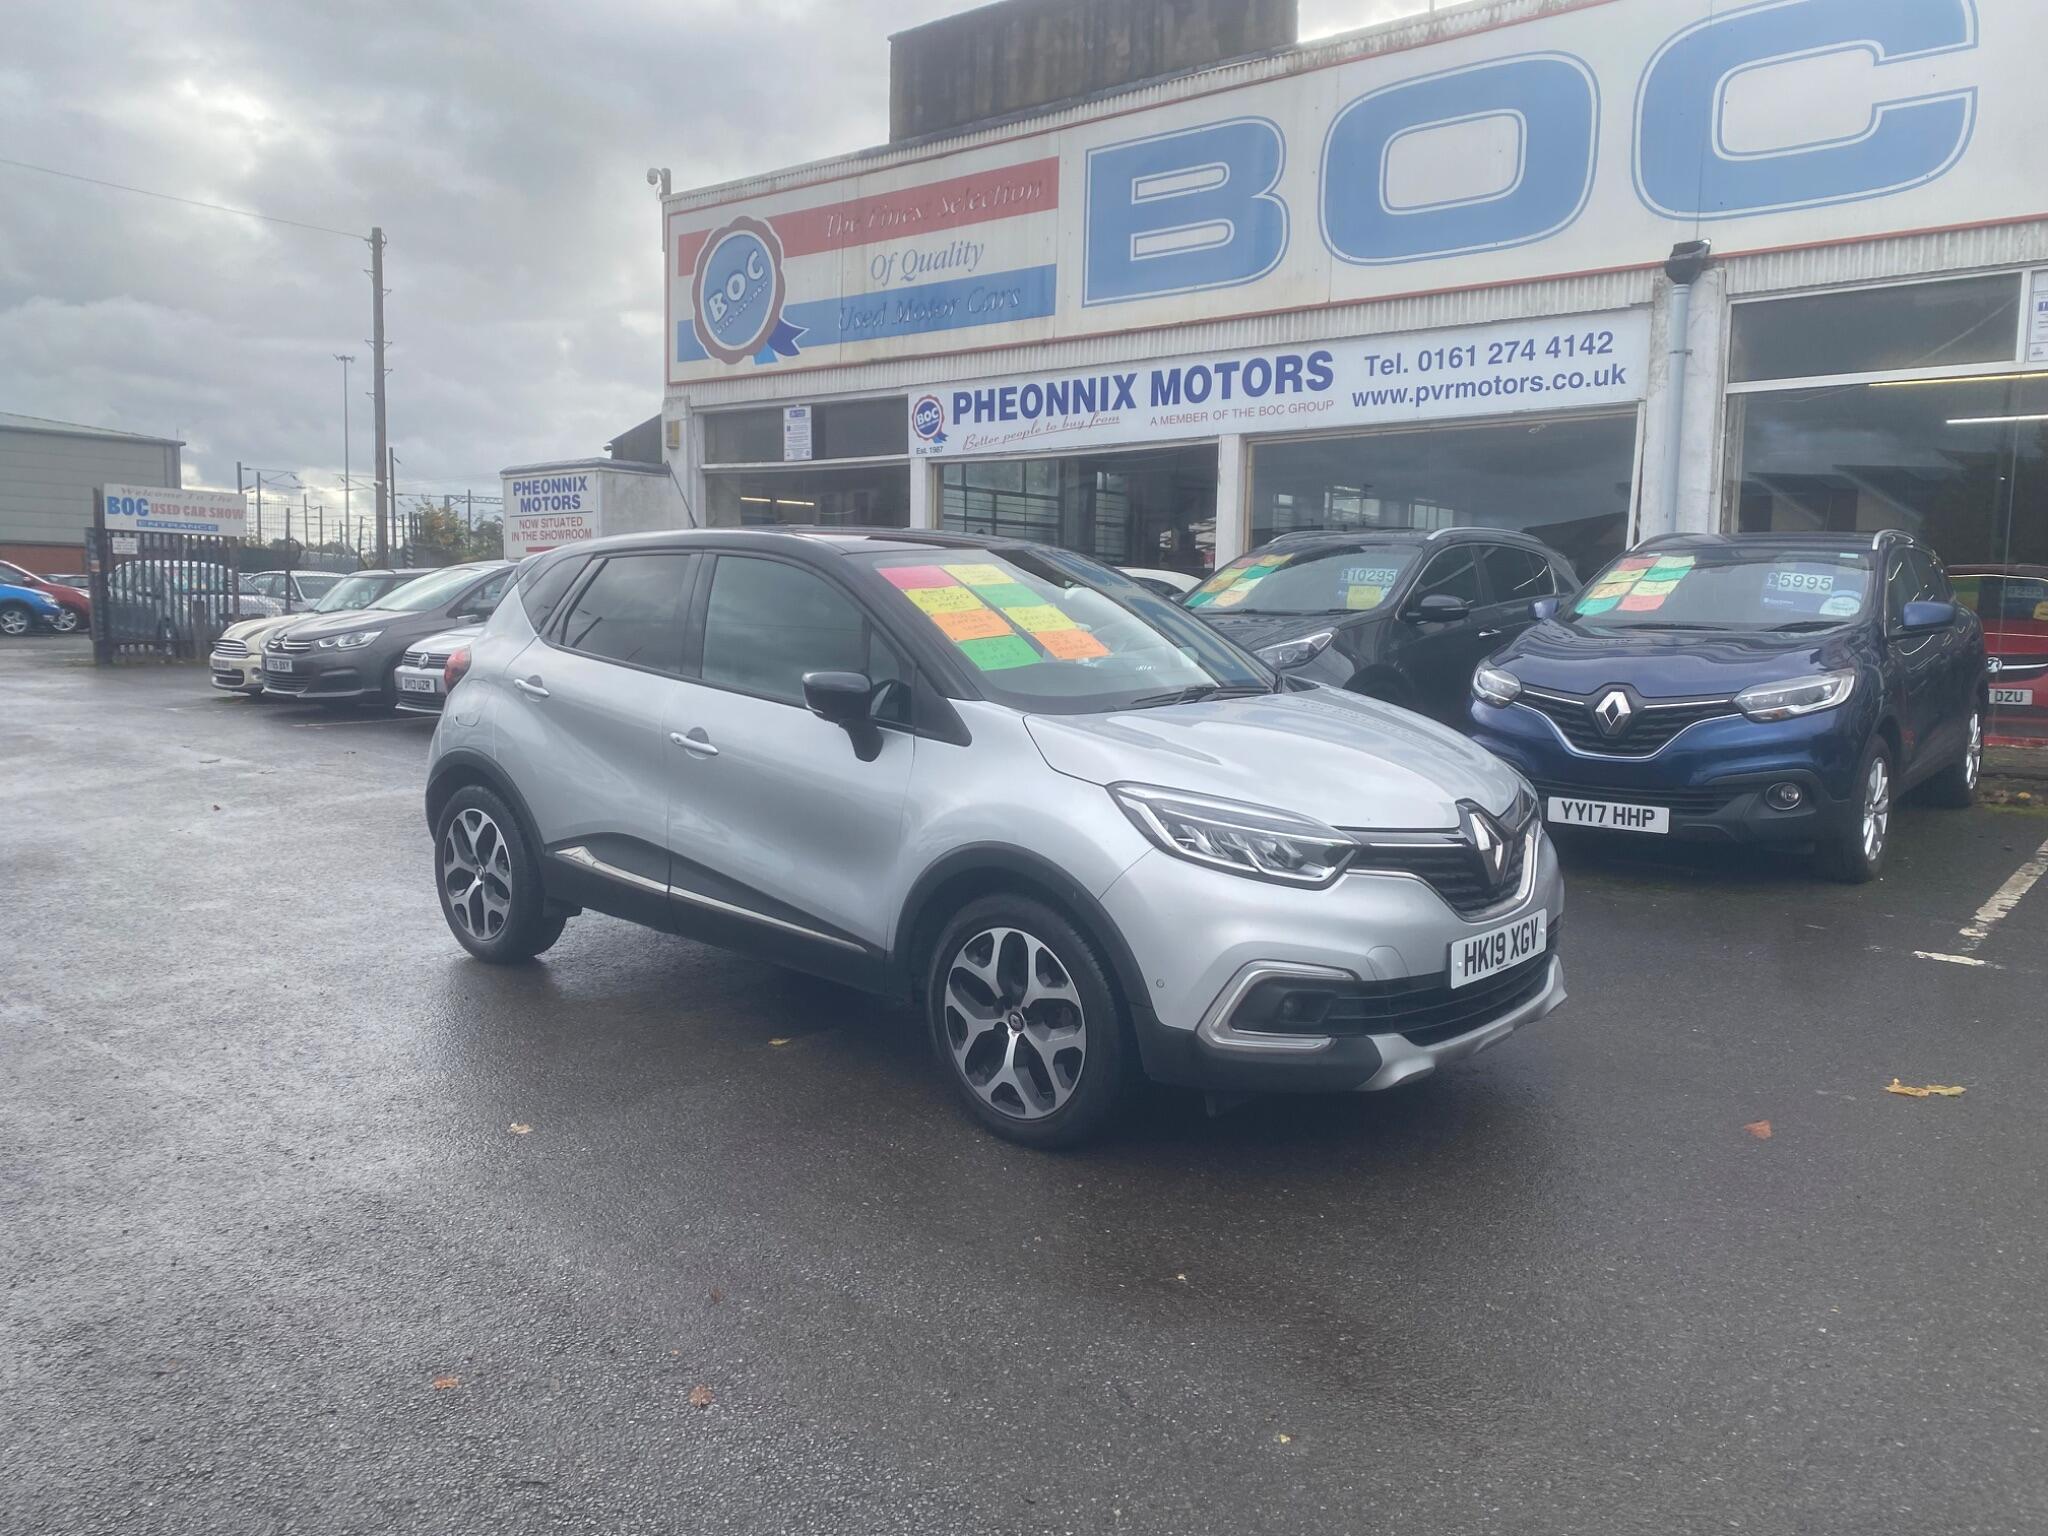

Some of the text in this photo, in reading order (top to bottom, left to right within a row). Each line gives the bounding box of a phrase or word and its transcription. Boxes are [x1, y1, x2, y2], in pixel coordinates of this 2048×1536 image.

[1084, 0, 1978, 306] BOC
[870, 240, 985, 286] Of Quality
[708, 249, 765, 322] BOC
[838, 286, 1021, 332] Used Motor Cars
[1364, 330, 1614, 377] Tel. 0161 274 4142
[953, 350, 1334, 425] PHEONNIX MOTORS
[1352, 363, 1627, 408] www.pvrmotors.co.uk
[916, 407, 939, 426] BOC
[1150, 400, 1335, 427] A MEMBER OF THE BOC GROUP
[963, 409, 1120, 450] Better people to buy from
[512, 475, 588, 497] PHEONNIX
[106, 496, 246, 520] BOC USED CAR SHOW
[520, 494, 581, 513] MOTORS
[138, 520, 218, 532] ENTRANCE
[511, 528, 592, 542] IN THE SHOWROOM
[519, 516, 583, 530] NOW SITUATED
[1994, 690, 2024, 703] DZU
[1561, 800, 1656, 829] YY17 HHP
[1464, 917, 1539, 977] HK19 XGV
